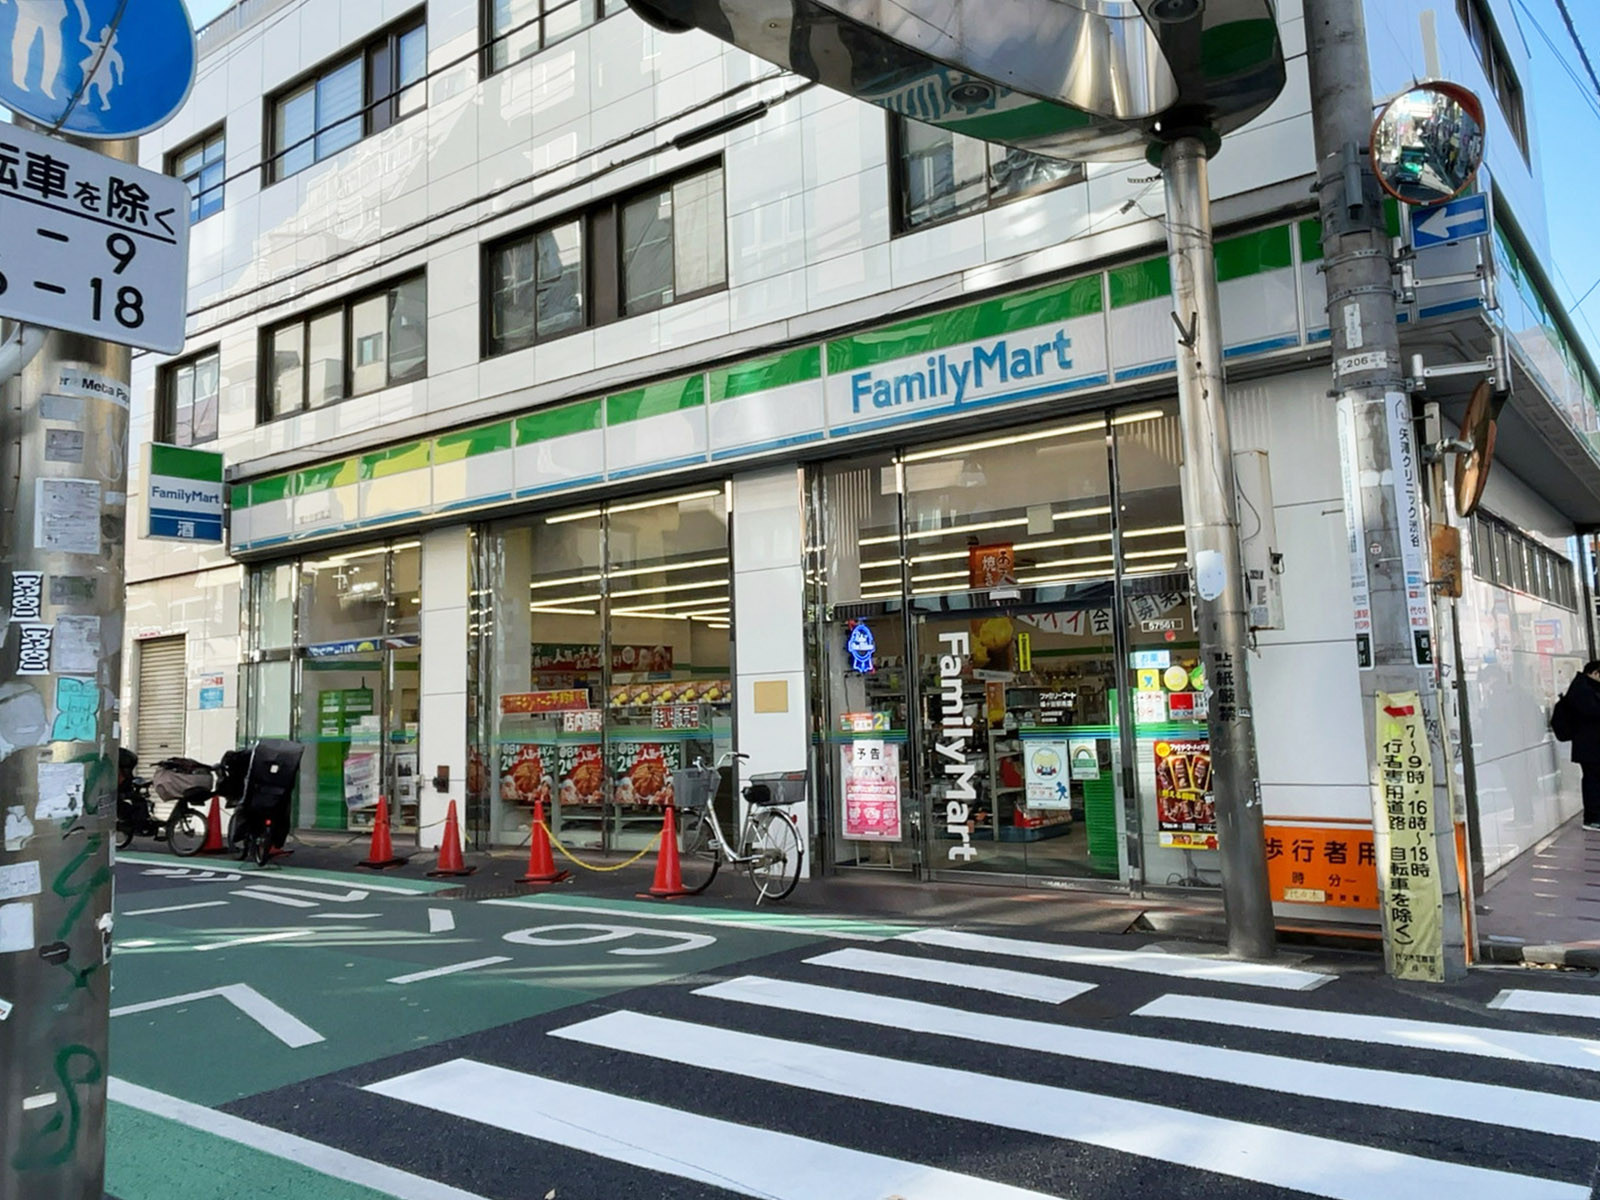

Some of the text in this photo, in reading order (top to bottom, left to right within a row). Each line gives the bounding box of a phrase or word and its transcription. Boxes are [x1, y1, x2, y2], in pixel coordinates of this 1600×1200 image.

[851, 328, 1073, 413] FamilyMart
[81, 378, 115, 395] Meta
[152, 486, 221, 505] FamilyMart
[177, 521, 196, 538] 酒
[857, 748, 881, 760] 予告
[936, 631, 978, 861] FamilyMart
